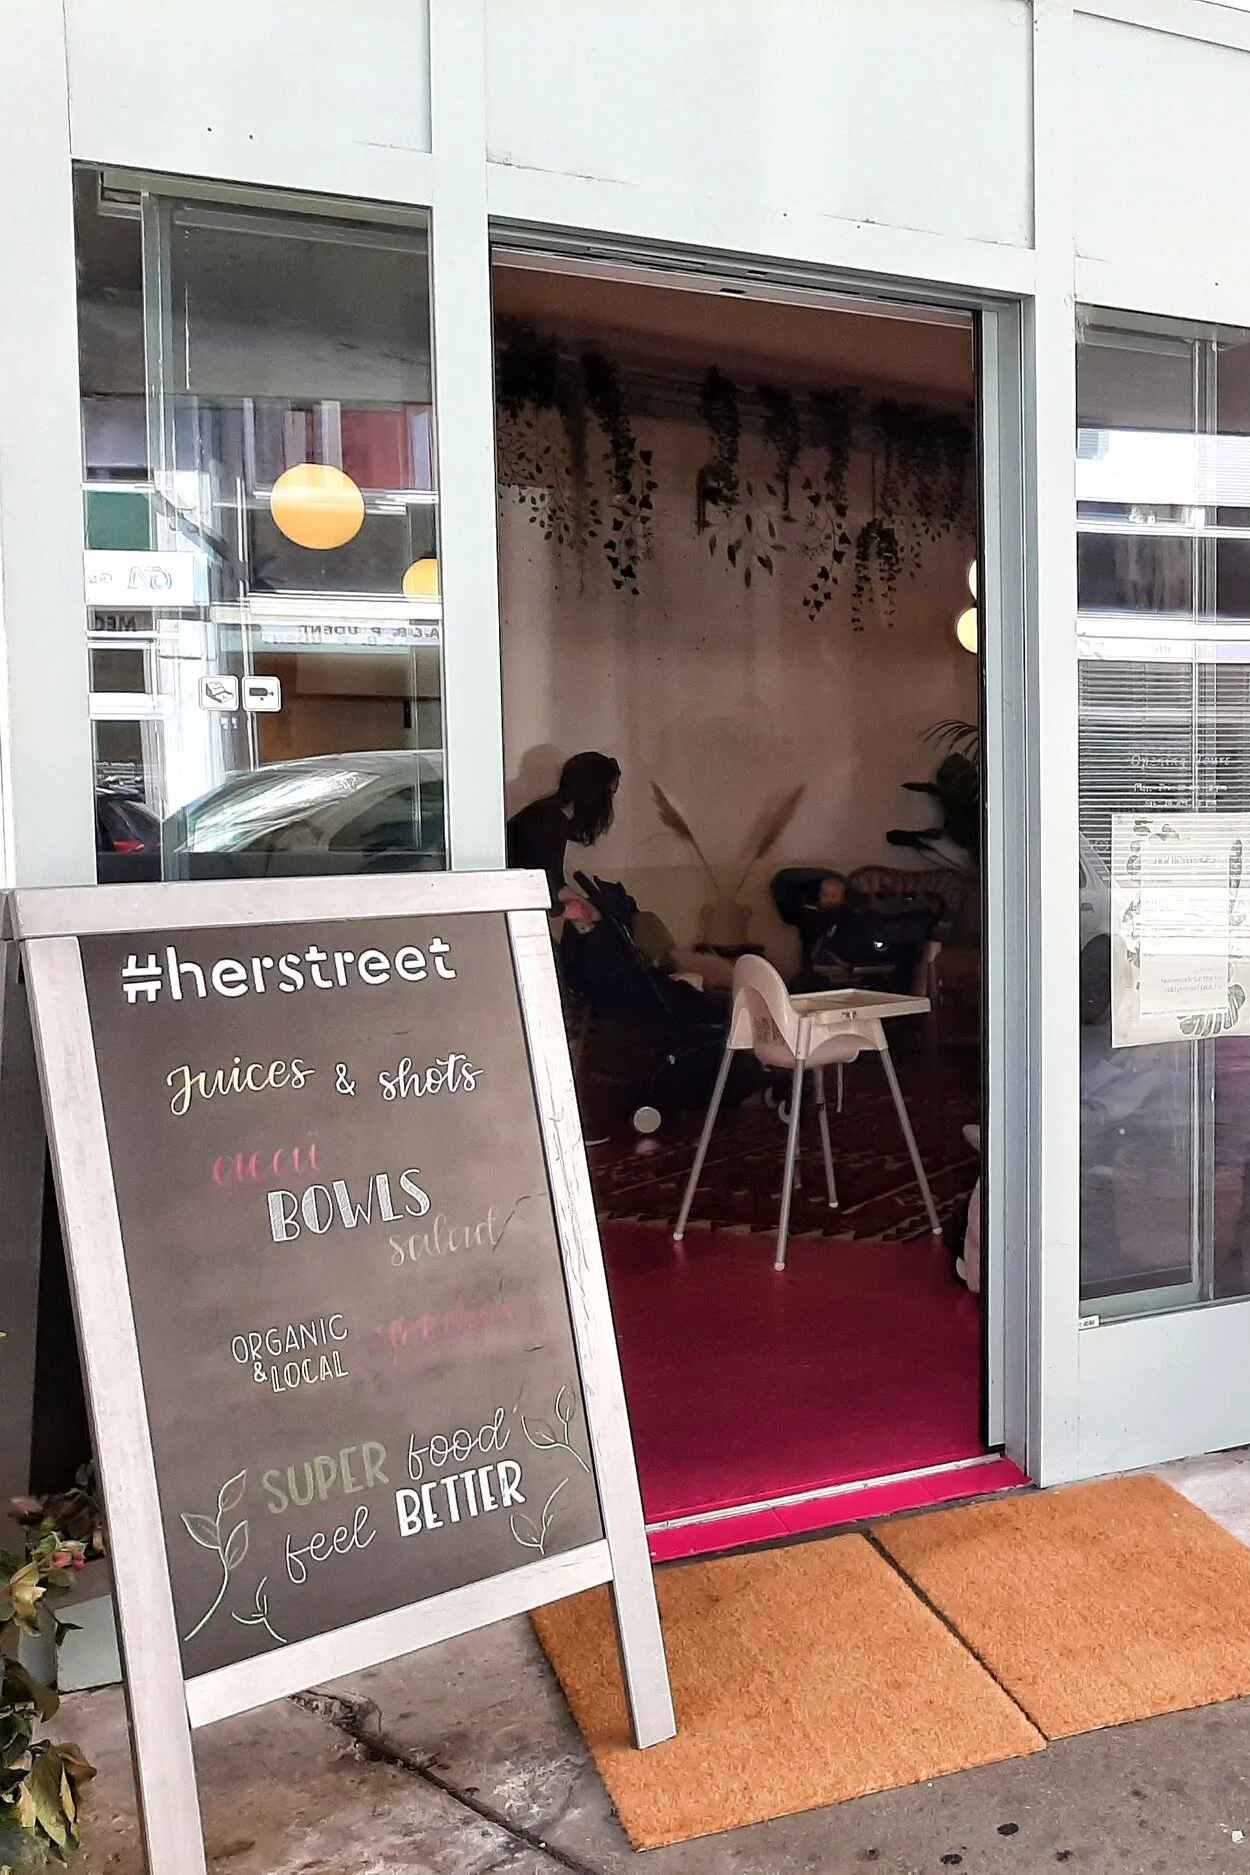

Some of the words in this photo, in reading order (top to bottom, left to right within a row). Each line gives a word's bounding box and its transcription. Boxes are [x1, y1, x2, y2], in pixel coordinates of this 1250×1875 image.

[121, 937, 457, 1003] #herstreet
[166, 1057, 315, 1116] Juices
[335, 1064, 355, 1096] &
[379, 1054, 483, 1100] shots
[267, 1168, 431, 1243] BOWLS
[231, 1313, 348, 1363] ORGANIC
[262, 1441, 390, 1514] SUPER
[407, 1407, 510, 1480] food
[285, 1506, 376, 1584] feel
[394, 1459, 526, 1538] BETTER
